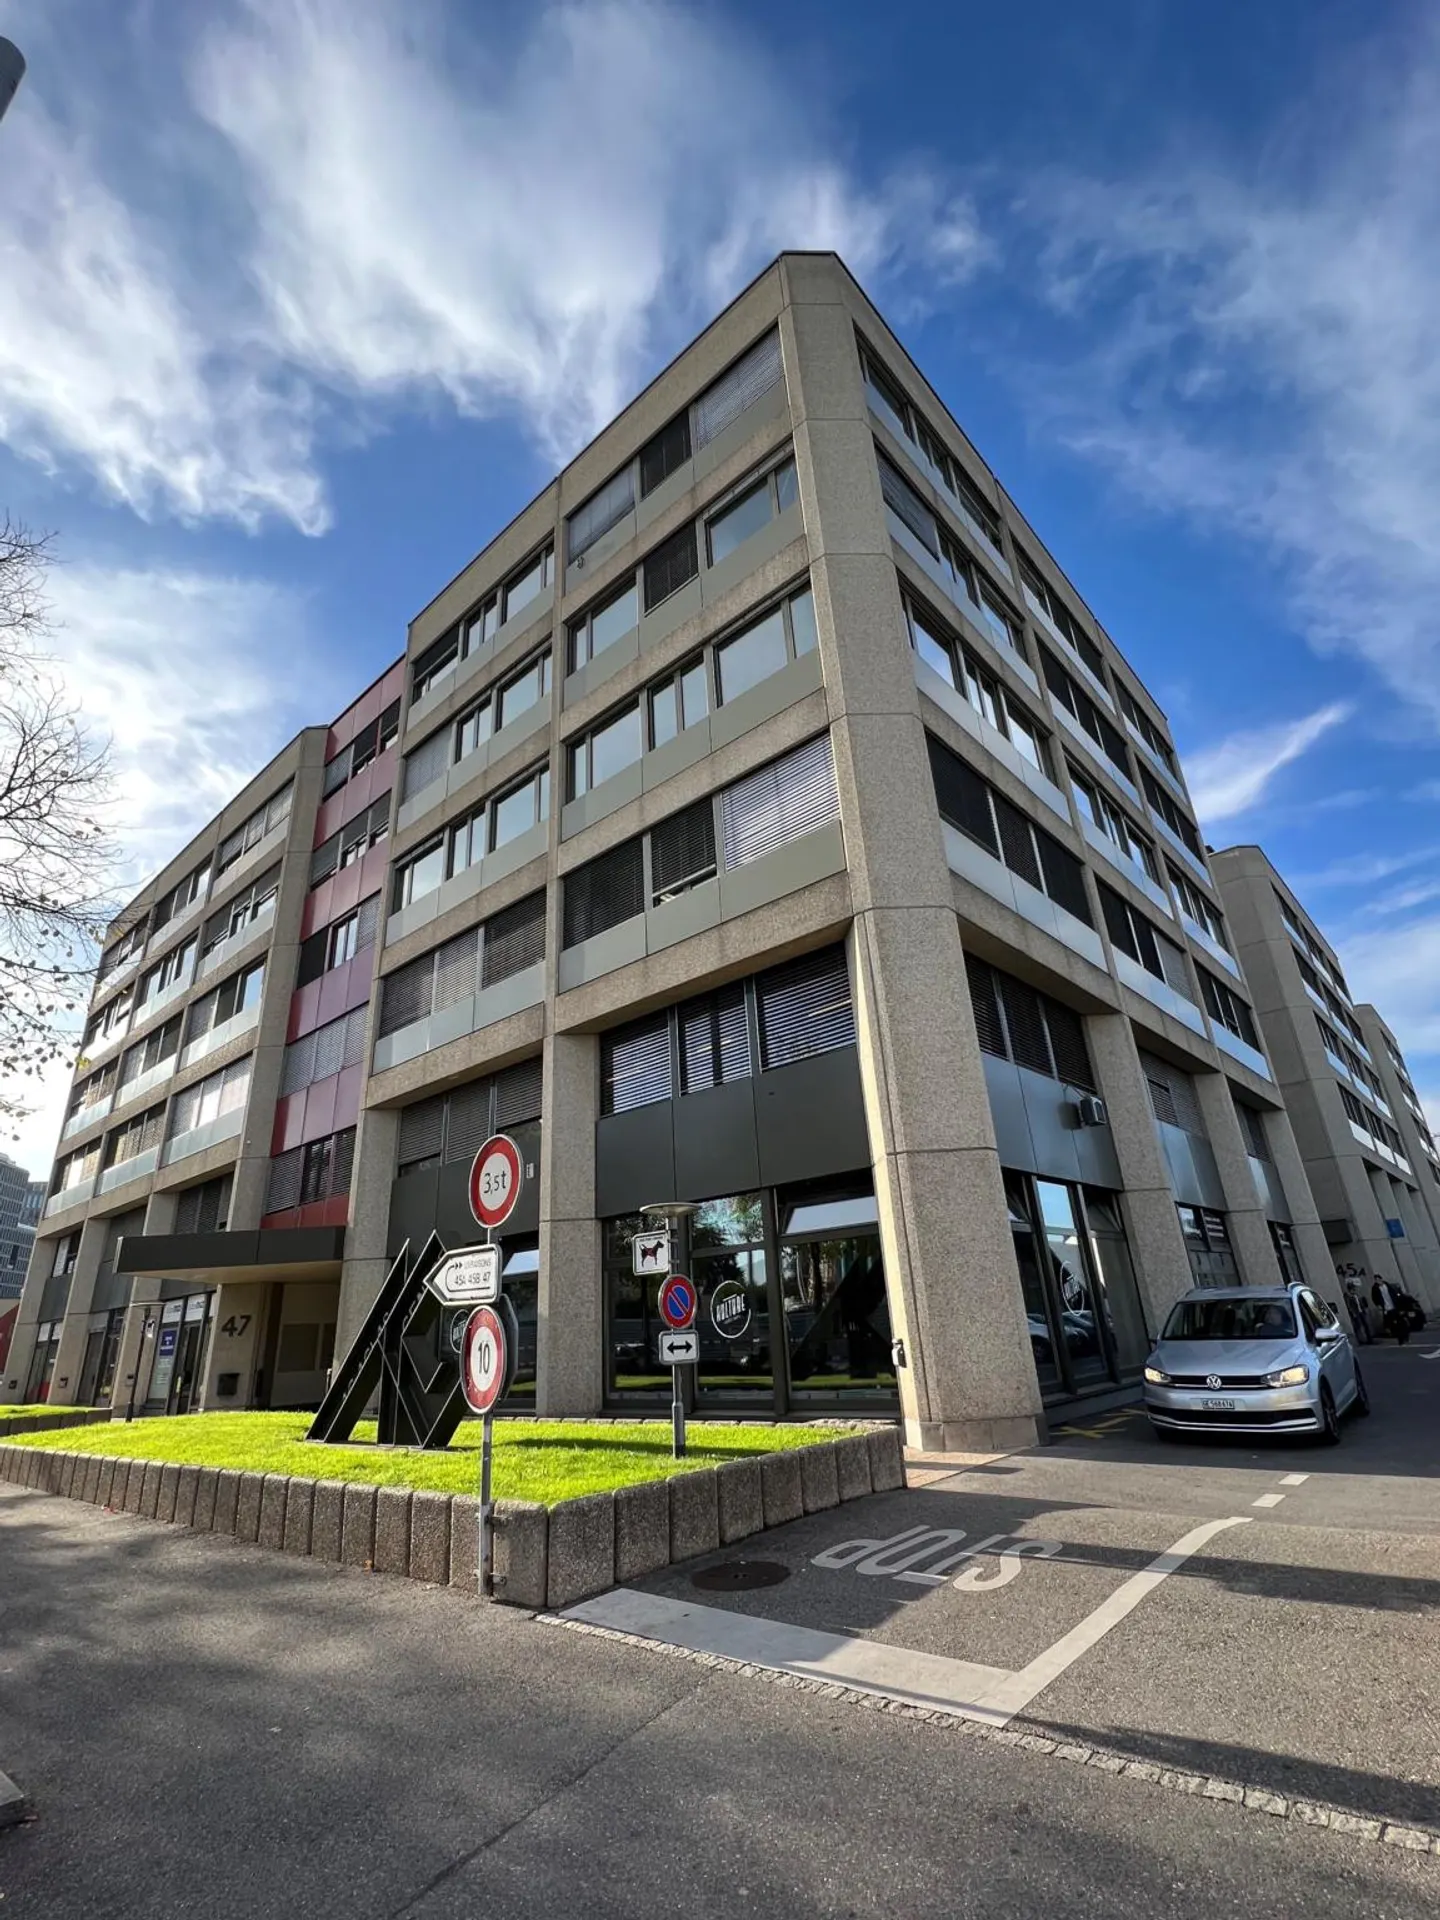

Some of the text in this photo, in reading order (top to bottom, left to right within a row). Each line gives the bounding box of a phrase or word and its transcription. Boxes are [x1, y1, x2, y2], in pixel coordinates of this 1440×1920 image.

[482, 1271, 491, 1282] 47
[1336, 1262, 1366, 1278] 45A
[221, 1314, 252, 1338] 47
[477, 1342, 490, 1375] 10
[811, 1524, 1063, 1592] STOP
